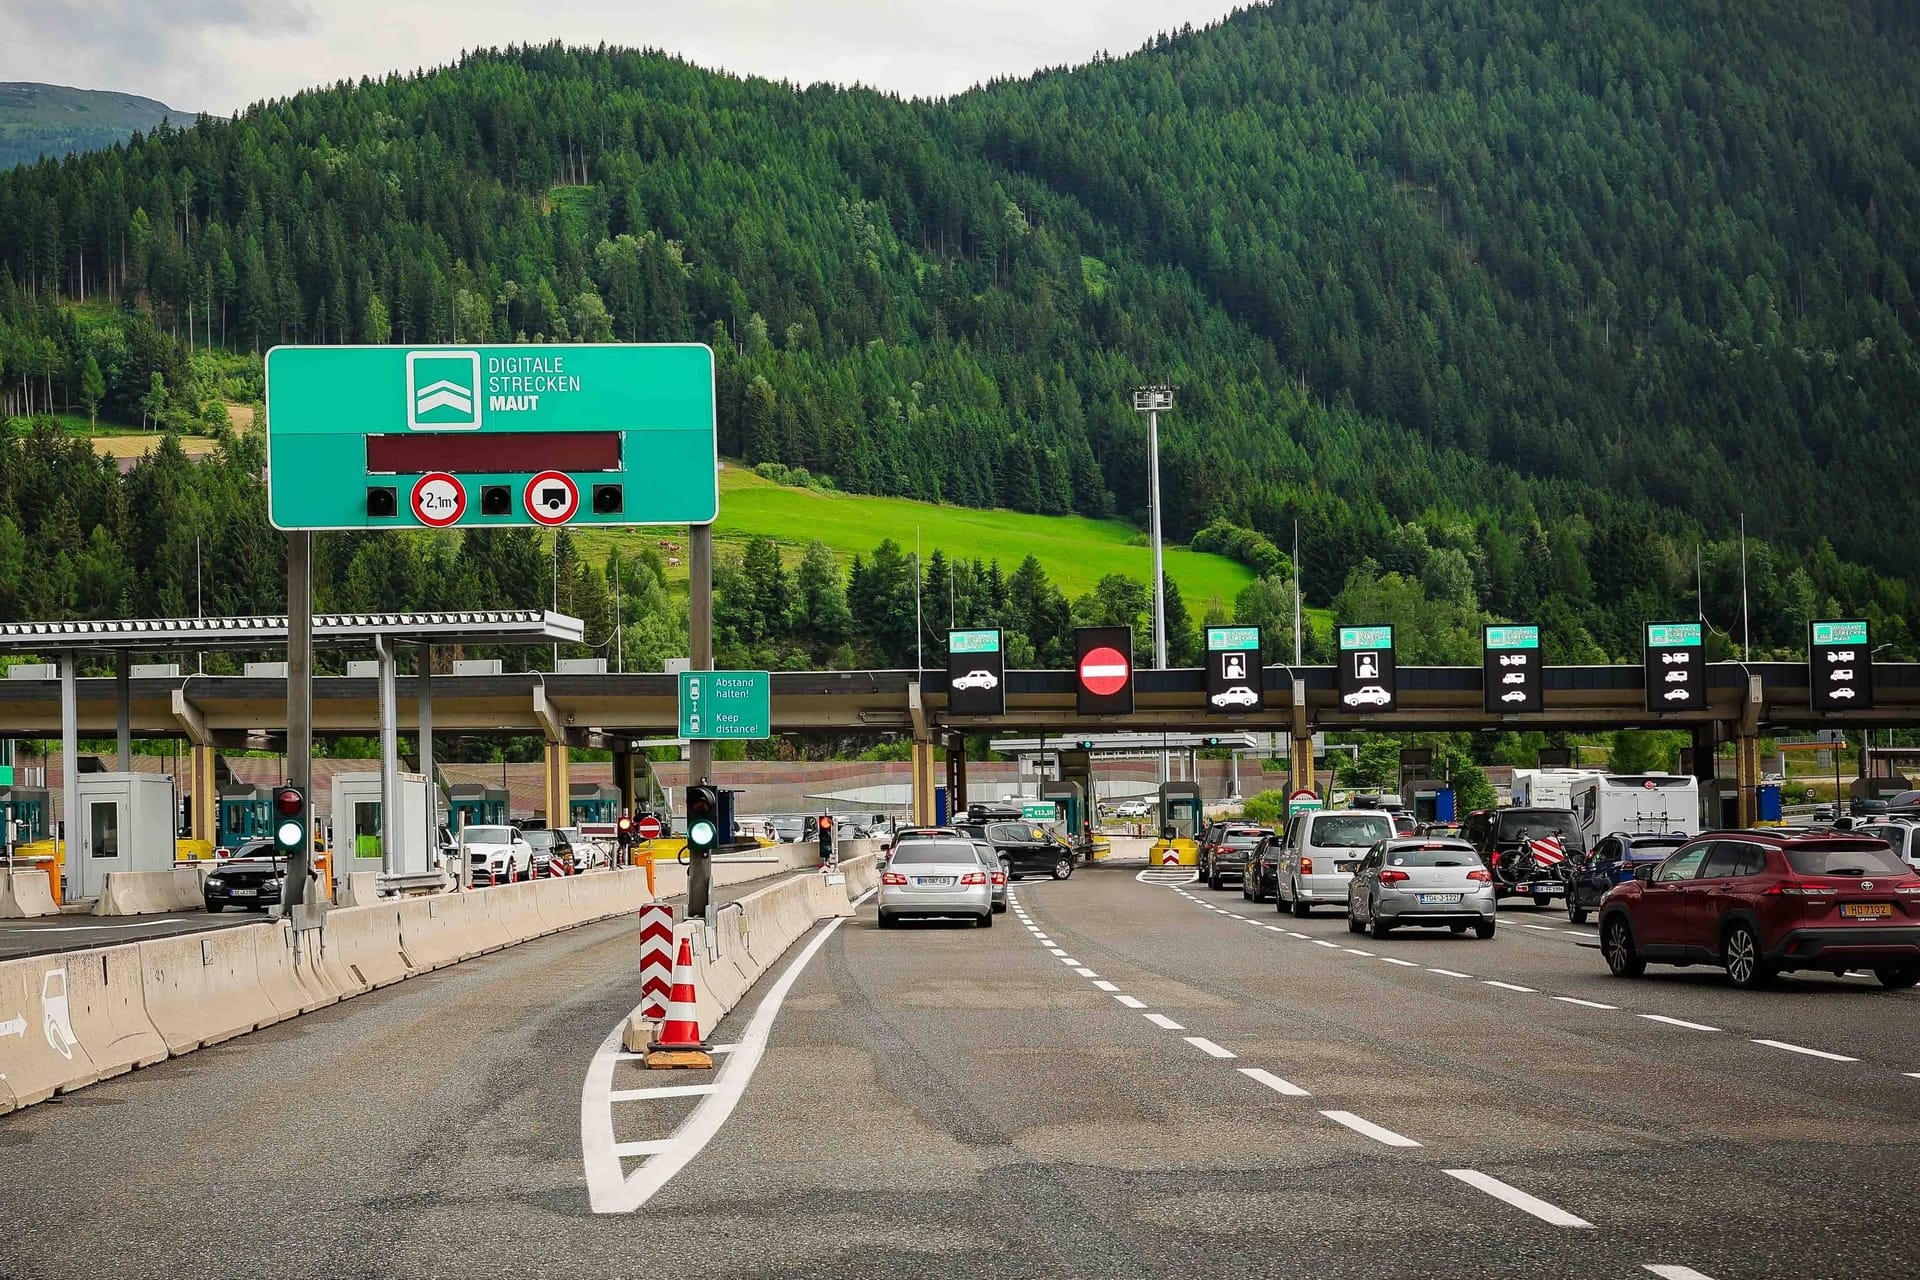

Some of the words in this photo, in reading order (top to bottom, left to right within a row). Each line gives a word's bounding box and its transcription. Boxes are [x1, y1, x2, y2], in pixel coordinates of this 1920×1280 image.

[489, 357, 564, 373] DIGITALE
[489, 376, 580, 392] STRECKEN
[489, 395, 539, 411] MAUT
[426, 492, 452, 510] 2,1m
[715, 678, 754, 687] Abstand
[716, 689, 749, 698] halten!
[716, 713, 739, 723] Keep
[716, 724, 758, 733] distance!
[1864, 903, 1886, 914] 7132
